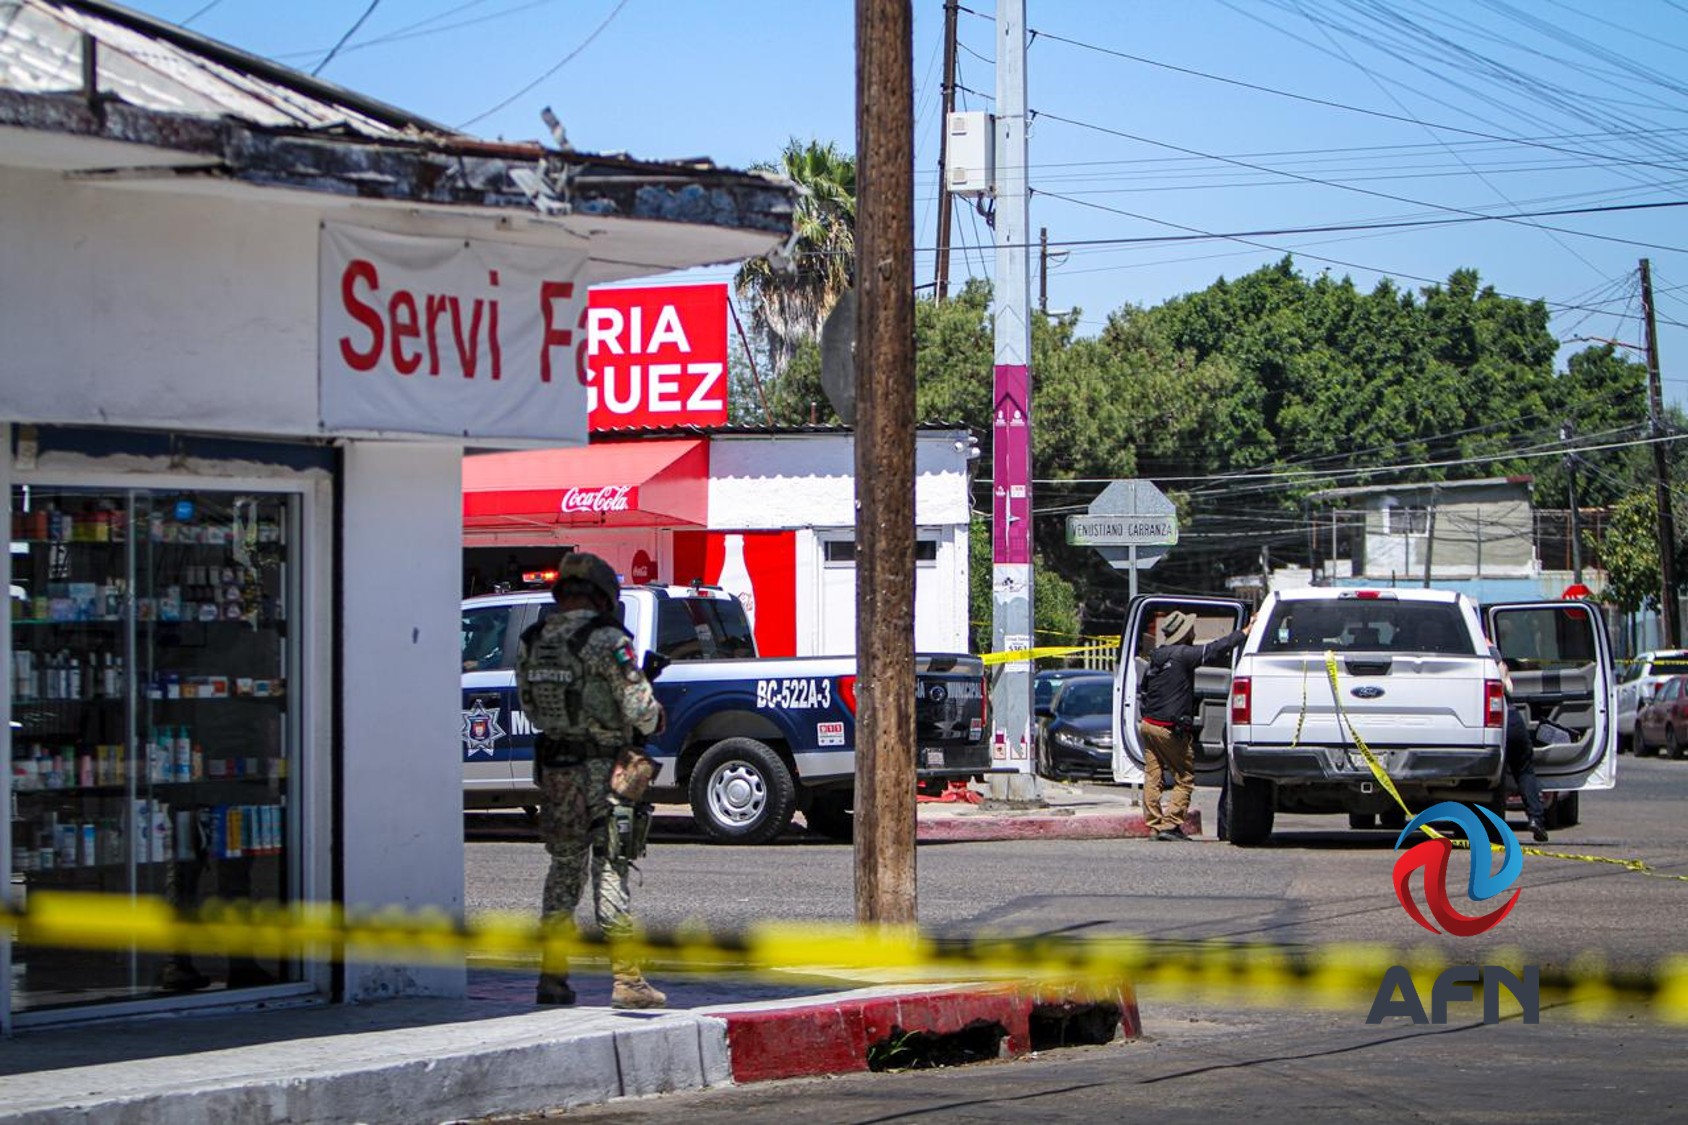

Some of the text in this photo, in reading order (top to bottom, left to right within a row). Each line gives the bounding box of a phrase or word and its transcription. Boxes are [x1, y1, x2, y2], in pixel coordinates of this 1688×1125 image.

[339, 259, 501, 381] Servi
[587, 305, 691, 355] RIA
[561, 485, 632, 513] Coca-Cola
[1071, 523, 1172, 537] VENUSTIANO CARRANZA
[756, 678, 831, 709] BC-522A-3
